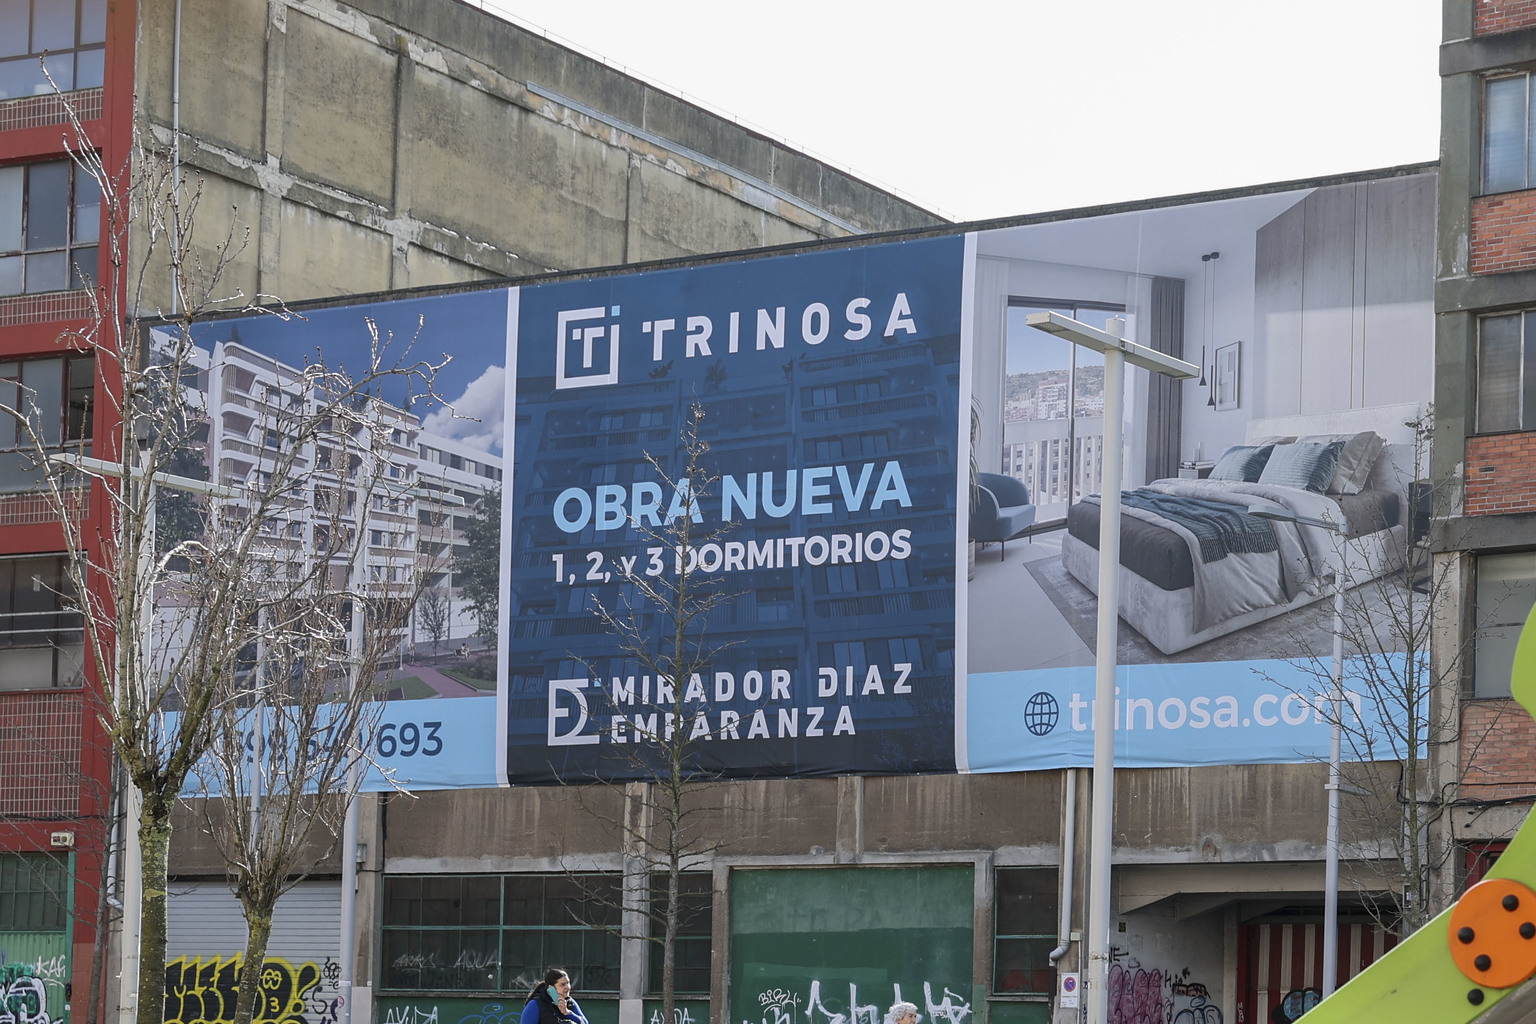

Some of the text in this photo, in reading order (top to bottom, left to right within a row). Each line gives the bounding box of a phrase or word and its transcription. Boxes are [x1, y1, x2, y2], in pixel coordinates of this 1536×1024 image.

[642, 292, 917, 361] TRINOSA
[553, 460, 912, 533] OBRA NUEVA
[552, 553, 576, 585] 1,
[586, 551, 611, 583] 2,
[645, 546, 664, 576] 3
[675, 529, 912, 575] DORMITORIOS
[611, 663, 912, 706] MIRADOR DIAZ
[1069, 687, 1361, 731] tinosa.com
[611, 705, 856, 744] EMPARANZA
